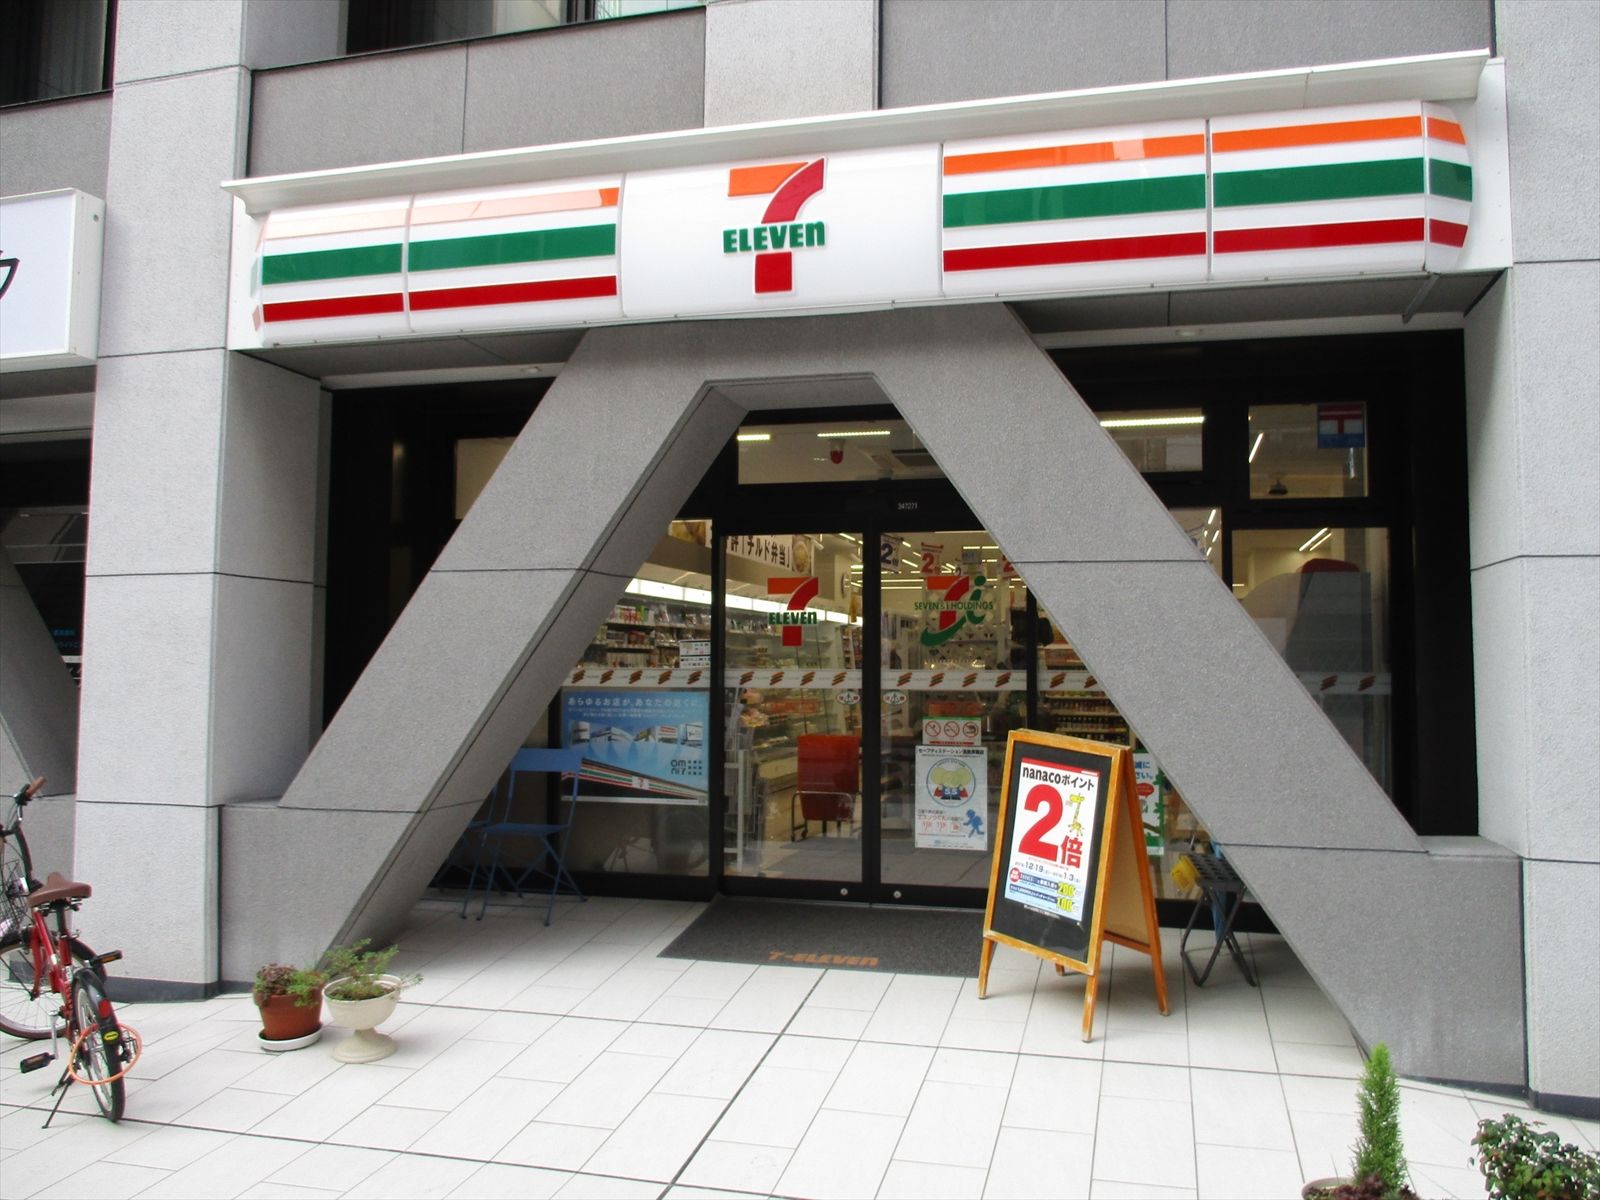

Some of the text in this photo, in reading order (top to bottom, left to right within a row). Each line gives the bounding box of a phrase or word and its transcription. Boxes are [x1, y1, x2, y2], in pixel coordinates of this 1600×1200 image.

[728, 158, 825, 294] 7
[914, 601, 939, 610] SEVEN
[951, 601, 993, 610] HOLDINGS
